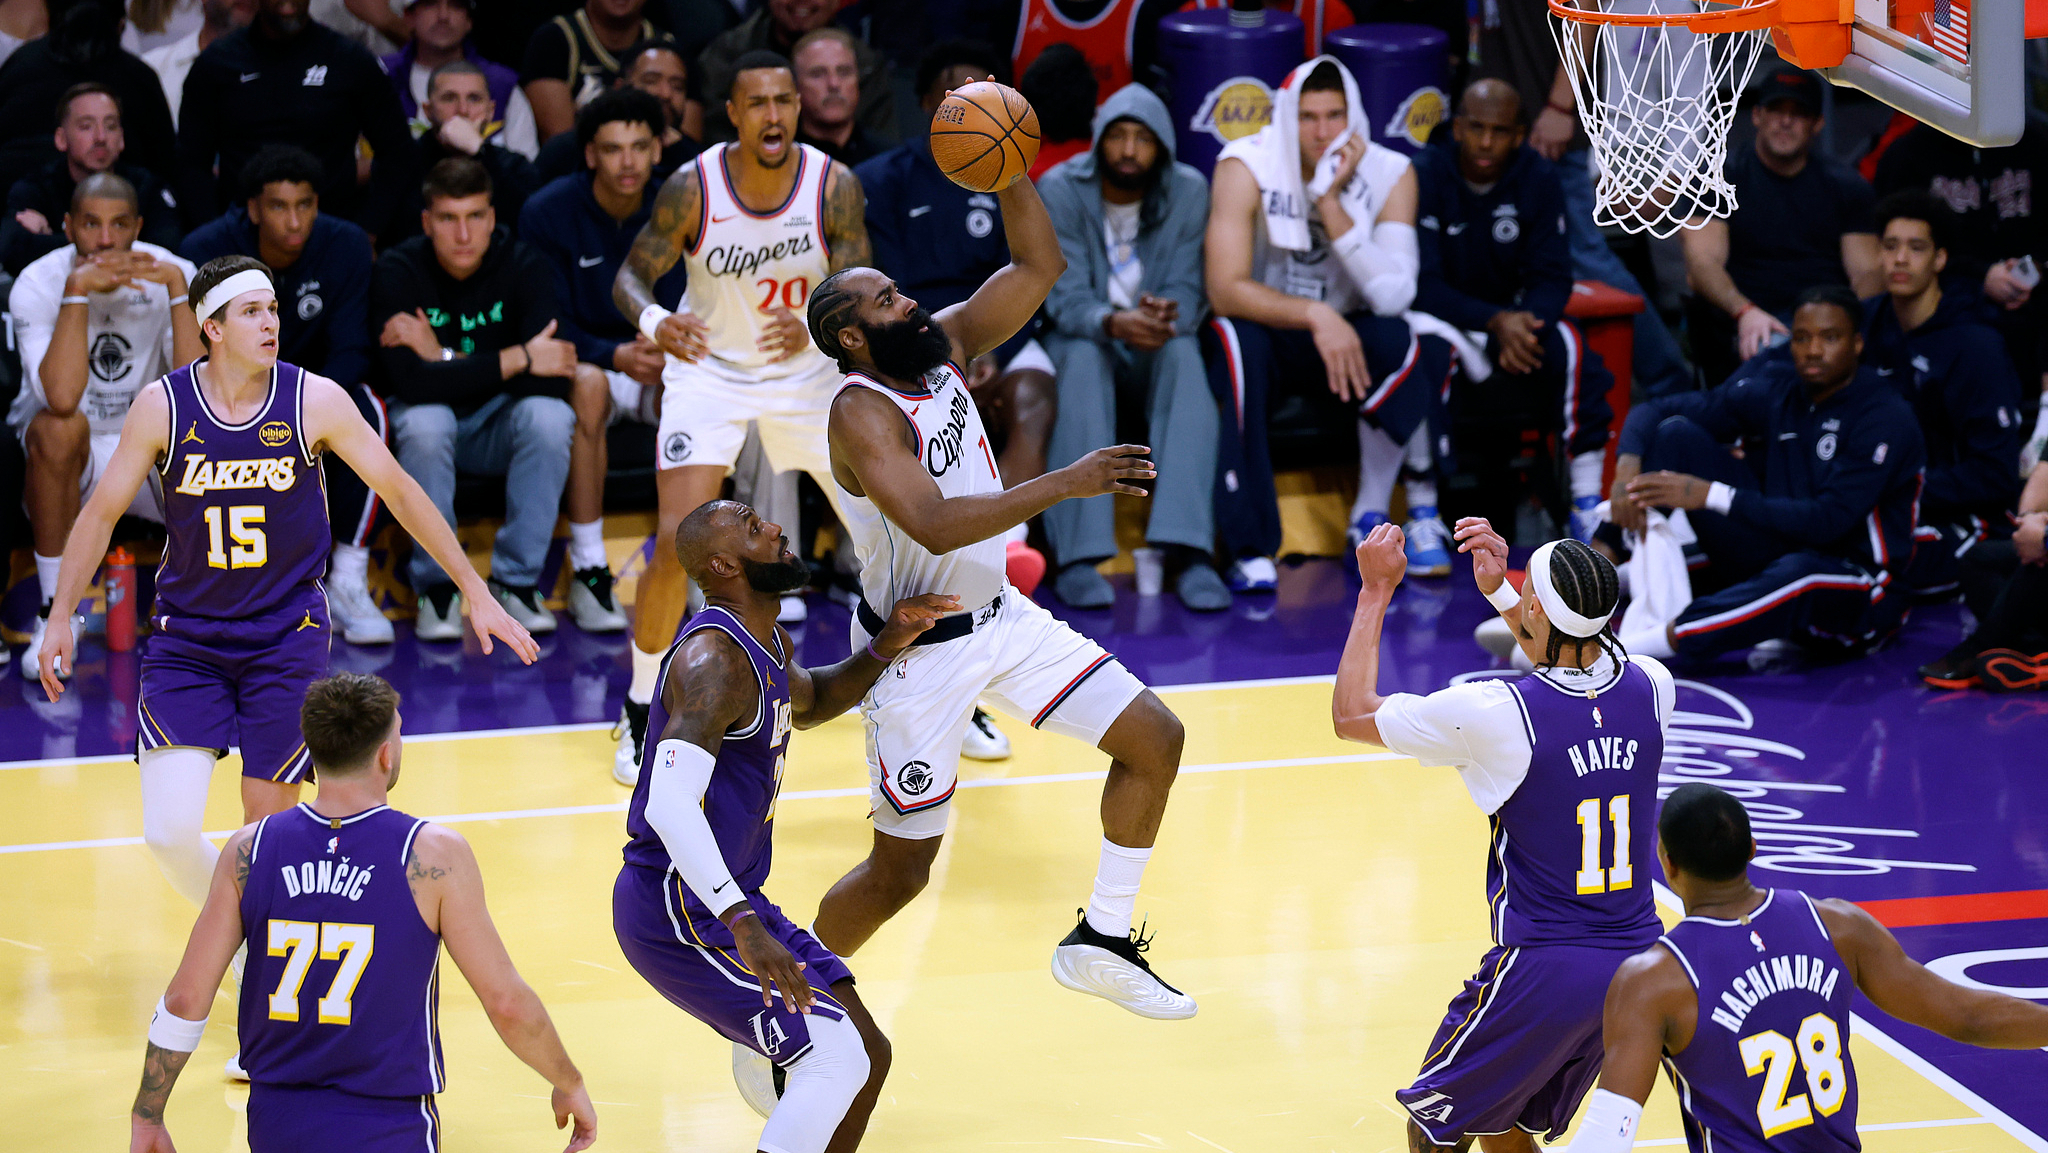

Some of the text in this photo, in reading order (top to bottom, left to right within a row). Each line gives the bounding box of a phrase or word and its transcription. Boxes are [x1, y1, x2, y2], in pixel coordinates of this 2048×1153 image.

[706, 232, 813, 279] Clippers
[756, 276, 808, 315] 20
[262, 427, 290, 440] bibigo
[927, 387, 969, 478] Clippers
[175, 453, 297, 497] LAKERS
[203, 504, 268, 571] 15
[1563, 669, 1580, 677] NIKE
[1567, 736, 1639, 778] HAYES
[1576, 793, 1633, 896] 11
[281, 856, 376, 902] DONČIĆ
[267, 918, 375, 1026] 77
[1710, 954, 1840, 1035] HACHIMURA
[1738, 1011, 1848, 1141] 28
